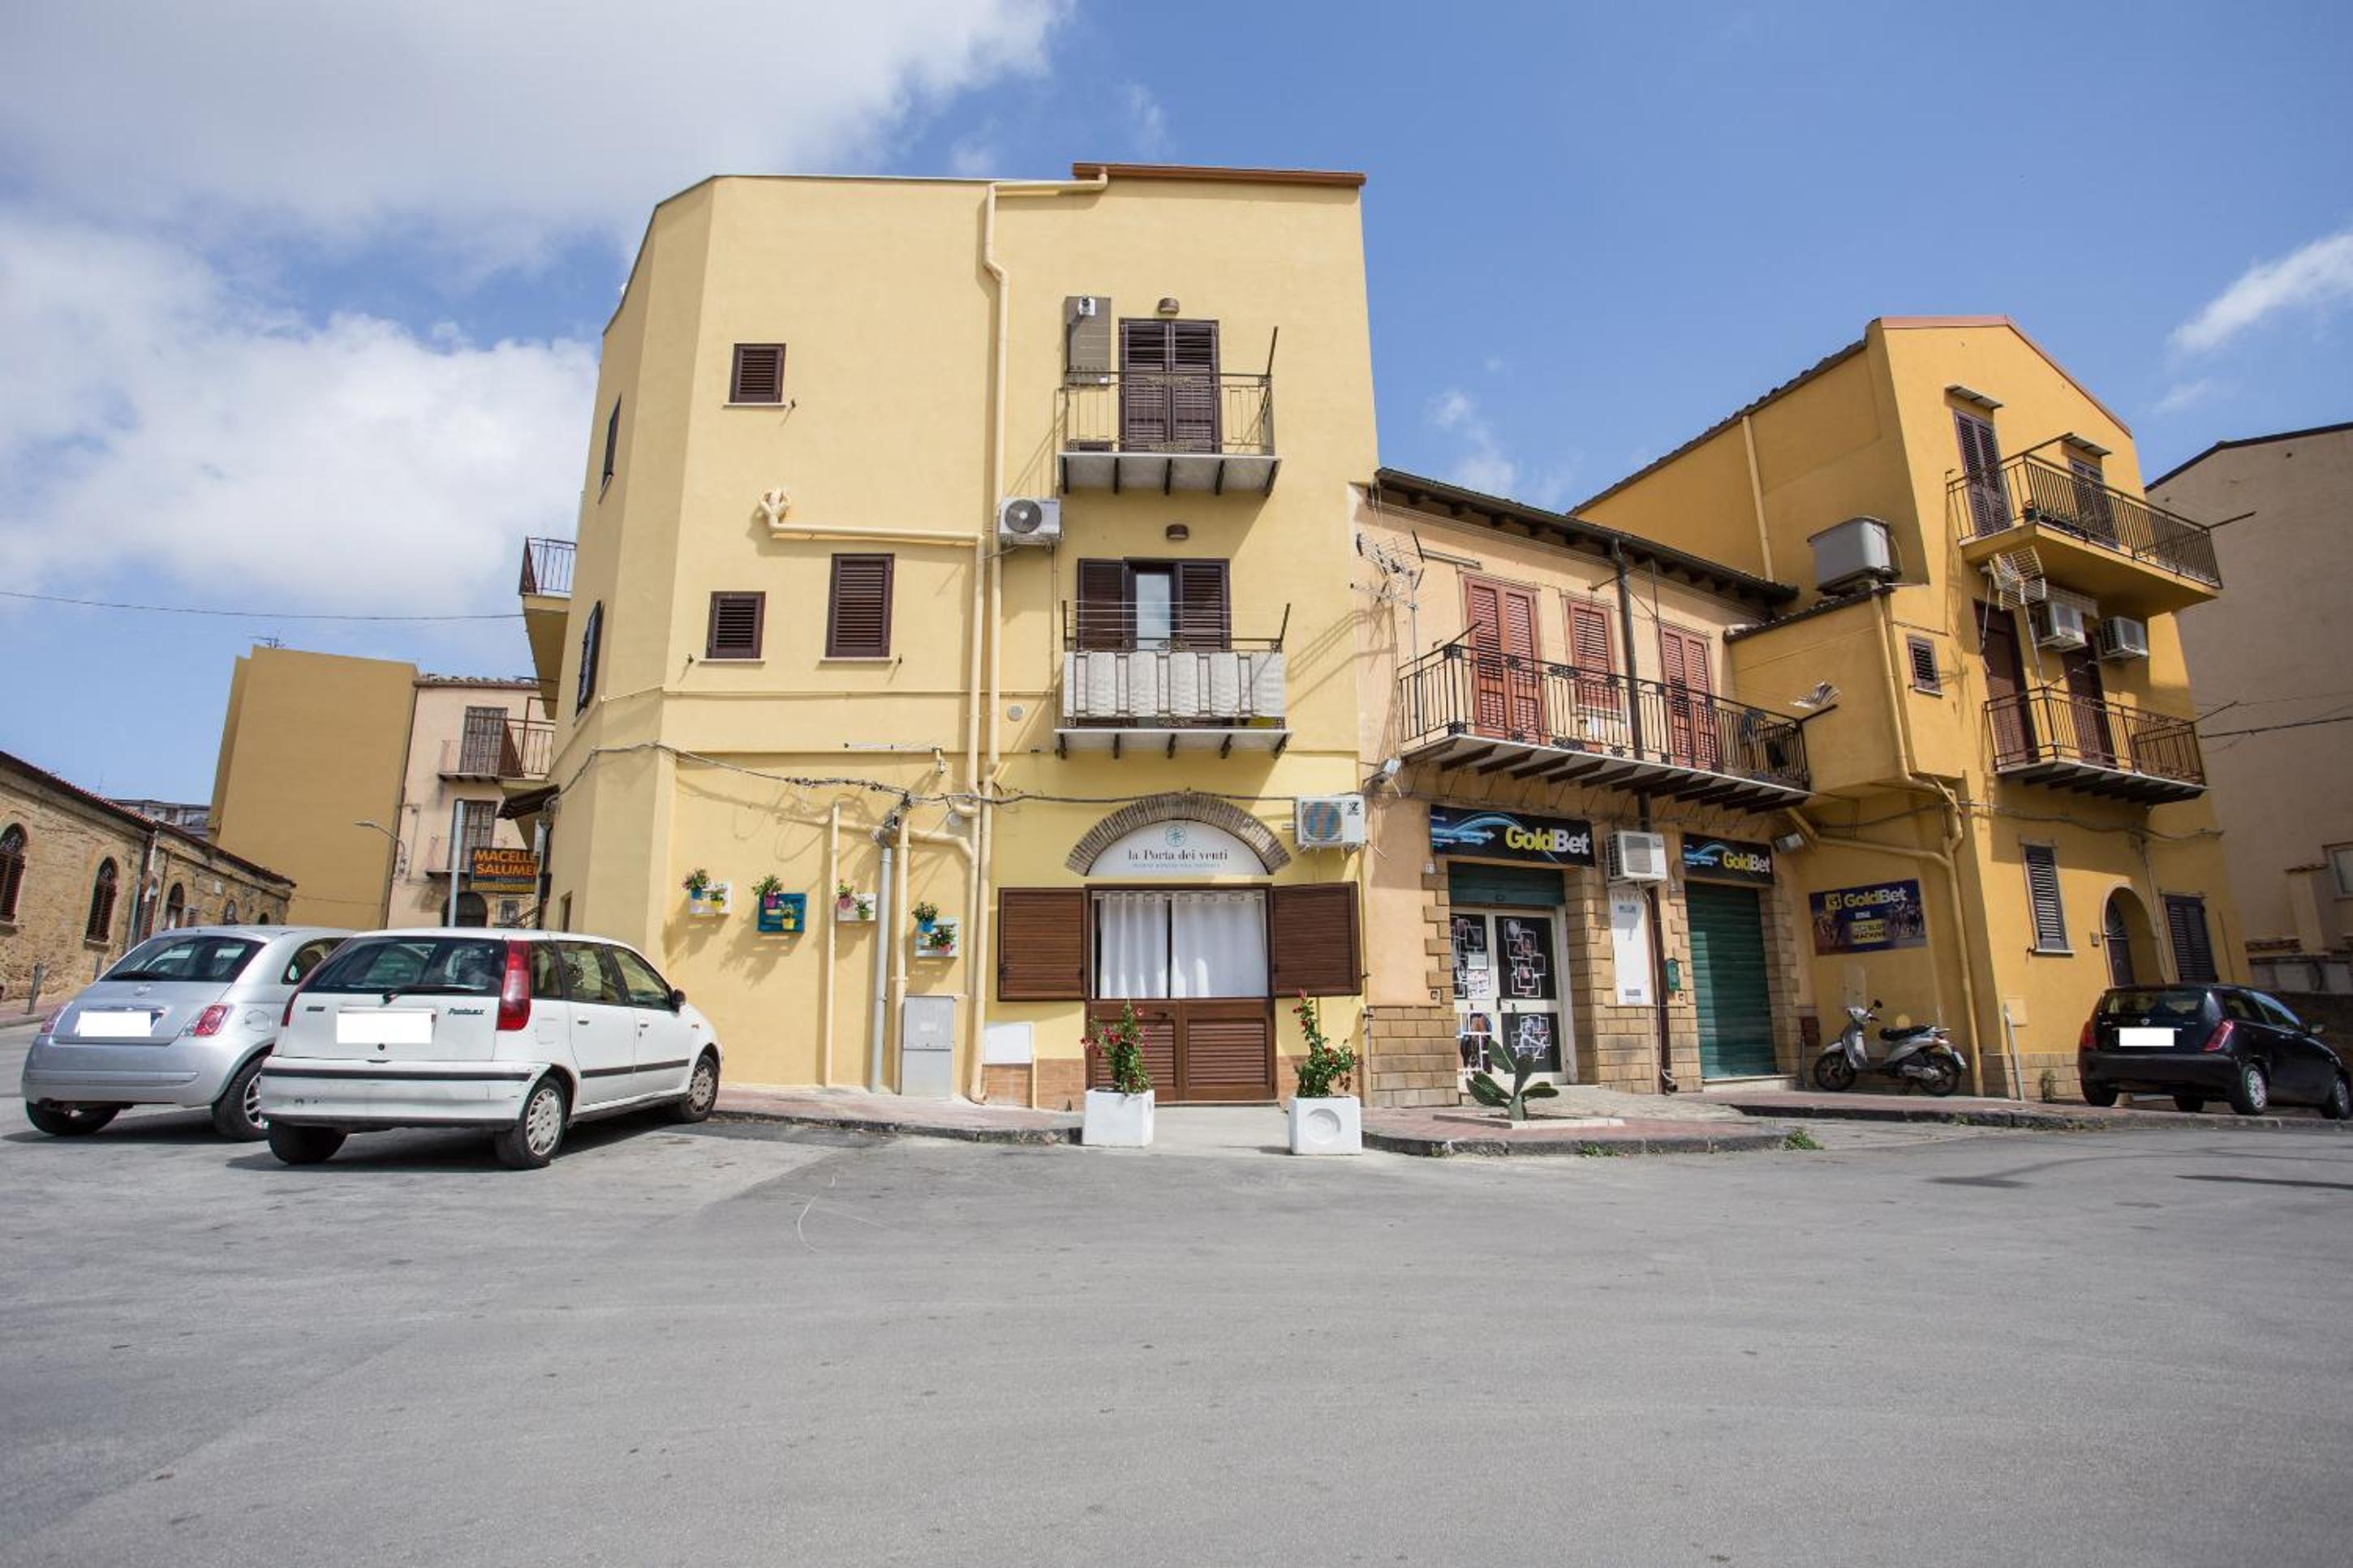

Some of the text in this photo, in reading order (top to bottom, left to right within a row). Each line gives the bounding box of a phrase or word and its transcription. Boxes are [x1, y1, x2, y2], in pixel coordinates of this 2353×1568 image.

[1505, 826, 1590, 854] GoldBet
[1129, 849, 1228, 860] la Porta dei venti
[1723, 851, 1770, 873] GoldBet
[1843, 887, 1908, 908] GoldBet
